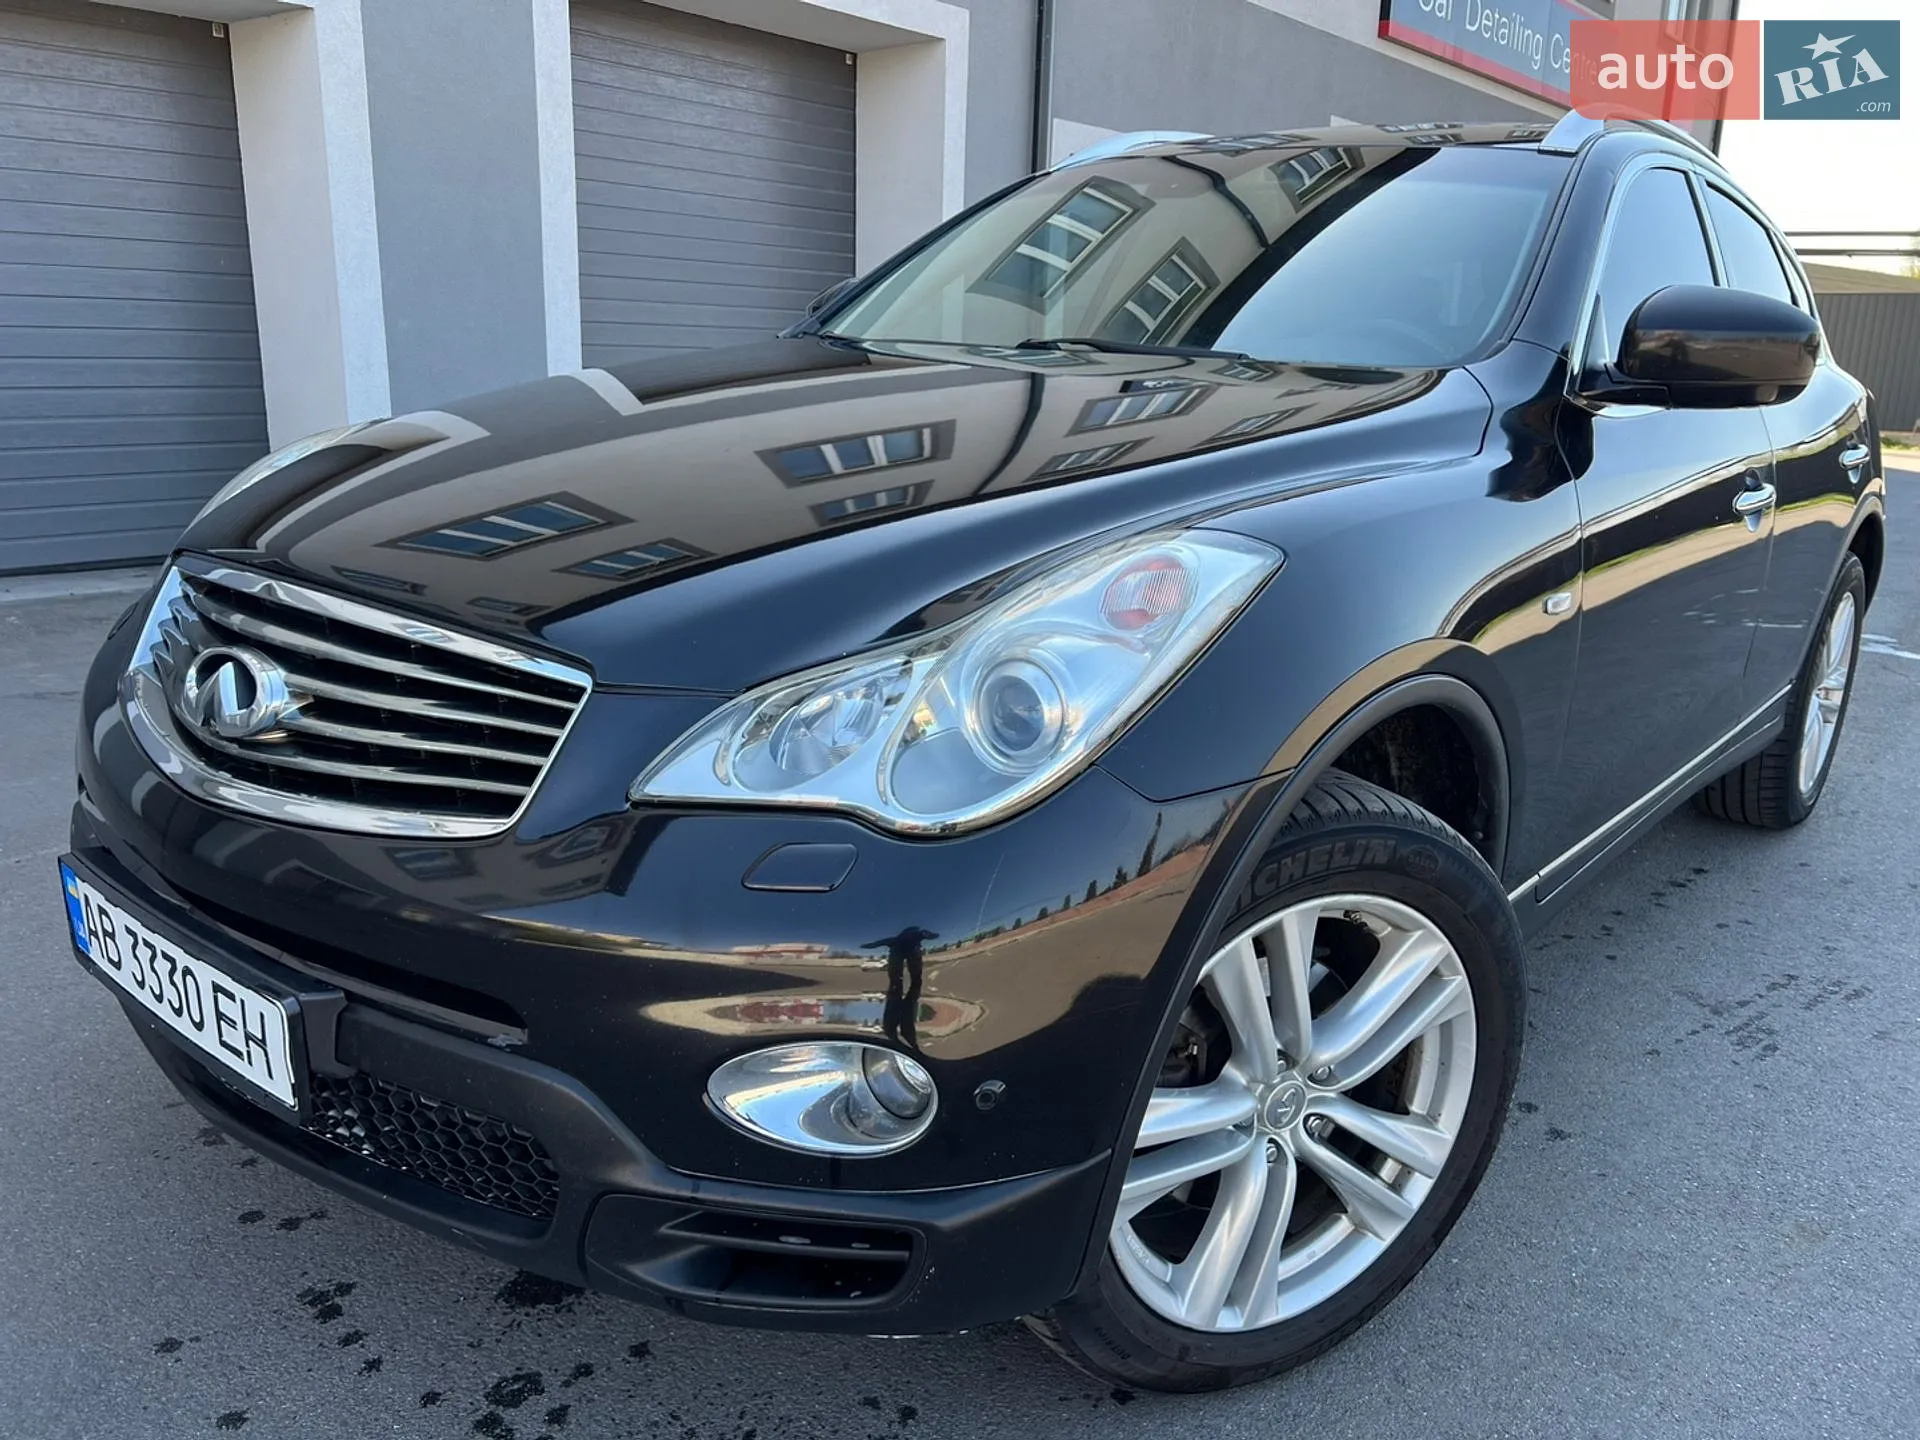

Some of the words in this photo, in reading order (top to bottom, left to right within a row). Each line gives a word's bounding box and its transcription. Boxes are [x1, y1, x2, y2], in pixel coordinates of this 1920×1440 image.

[1466, 0, 1543, 70] Detailing
[1234, 837, 1397, 910] ICHELIN
[84, 893, 122, 971] AB
[124, 924, 205, 1033] 3330
[211, 980, 274, 1080] EH
